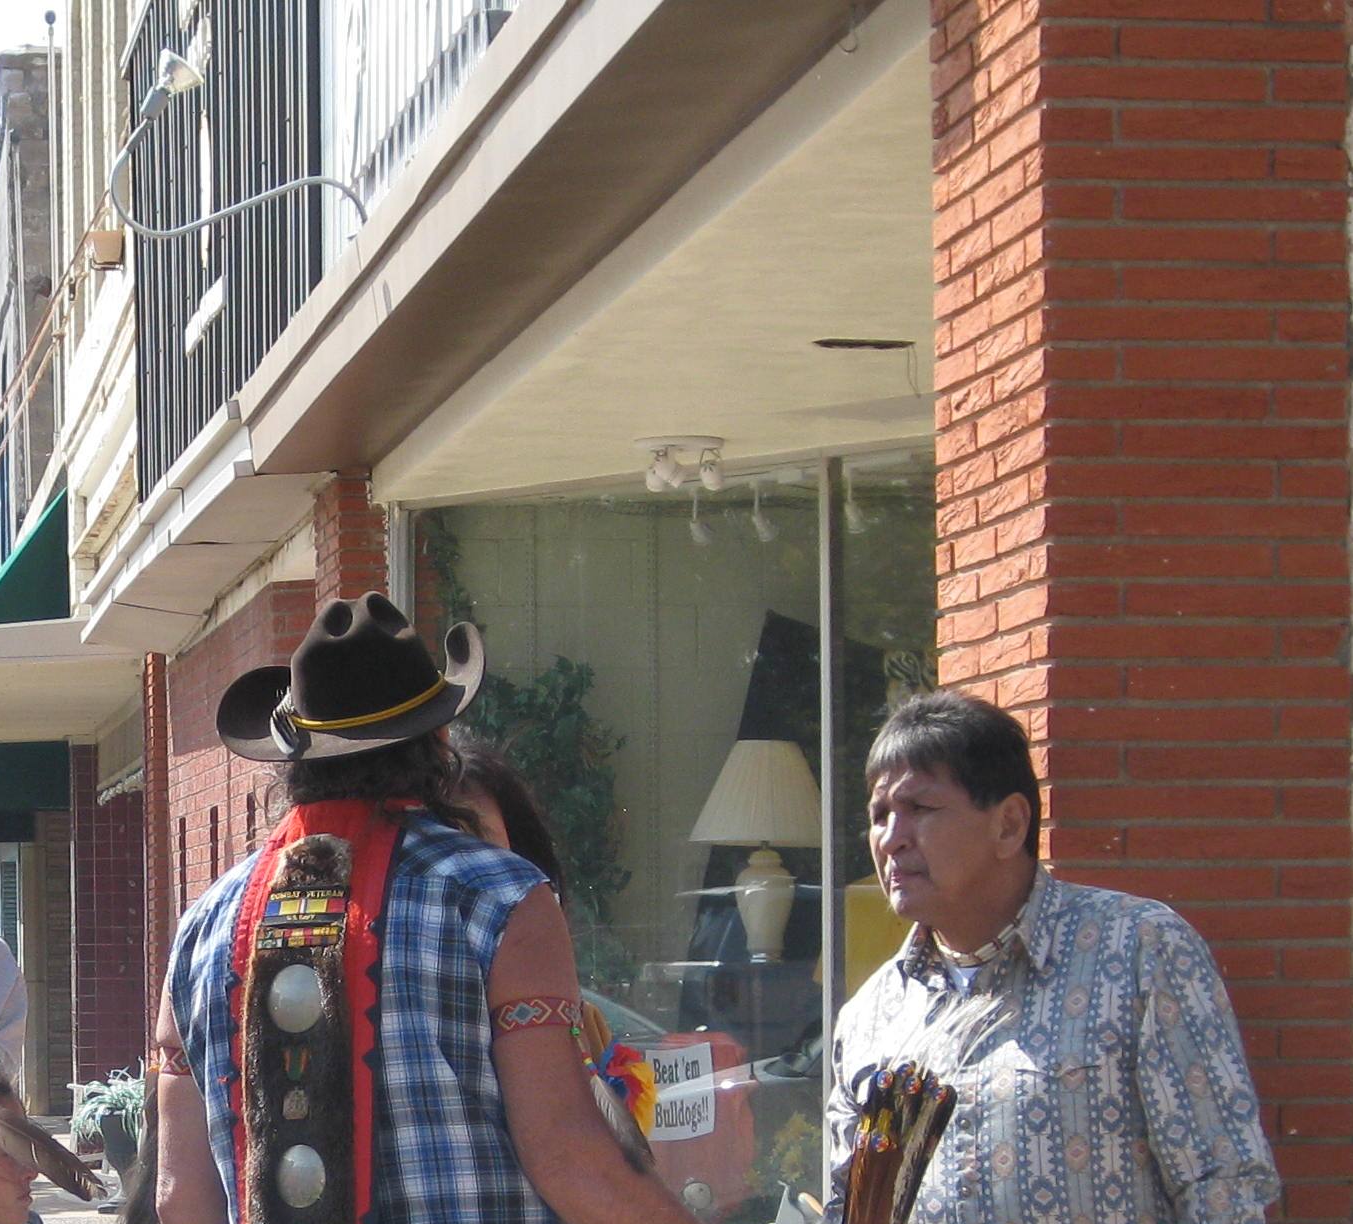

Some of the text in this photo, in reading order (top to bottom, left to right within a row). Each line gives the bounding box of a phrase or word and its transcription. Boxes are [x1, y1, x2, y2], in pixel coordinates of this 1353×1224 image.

[270, 890, 344, 901] COMBAT VETERAN
[653, 1056, 701, 1084] Beat 'em
[655, 1096, 709, 1133] Bulldogs!!
